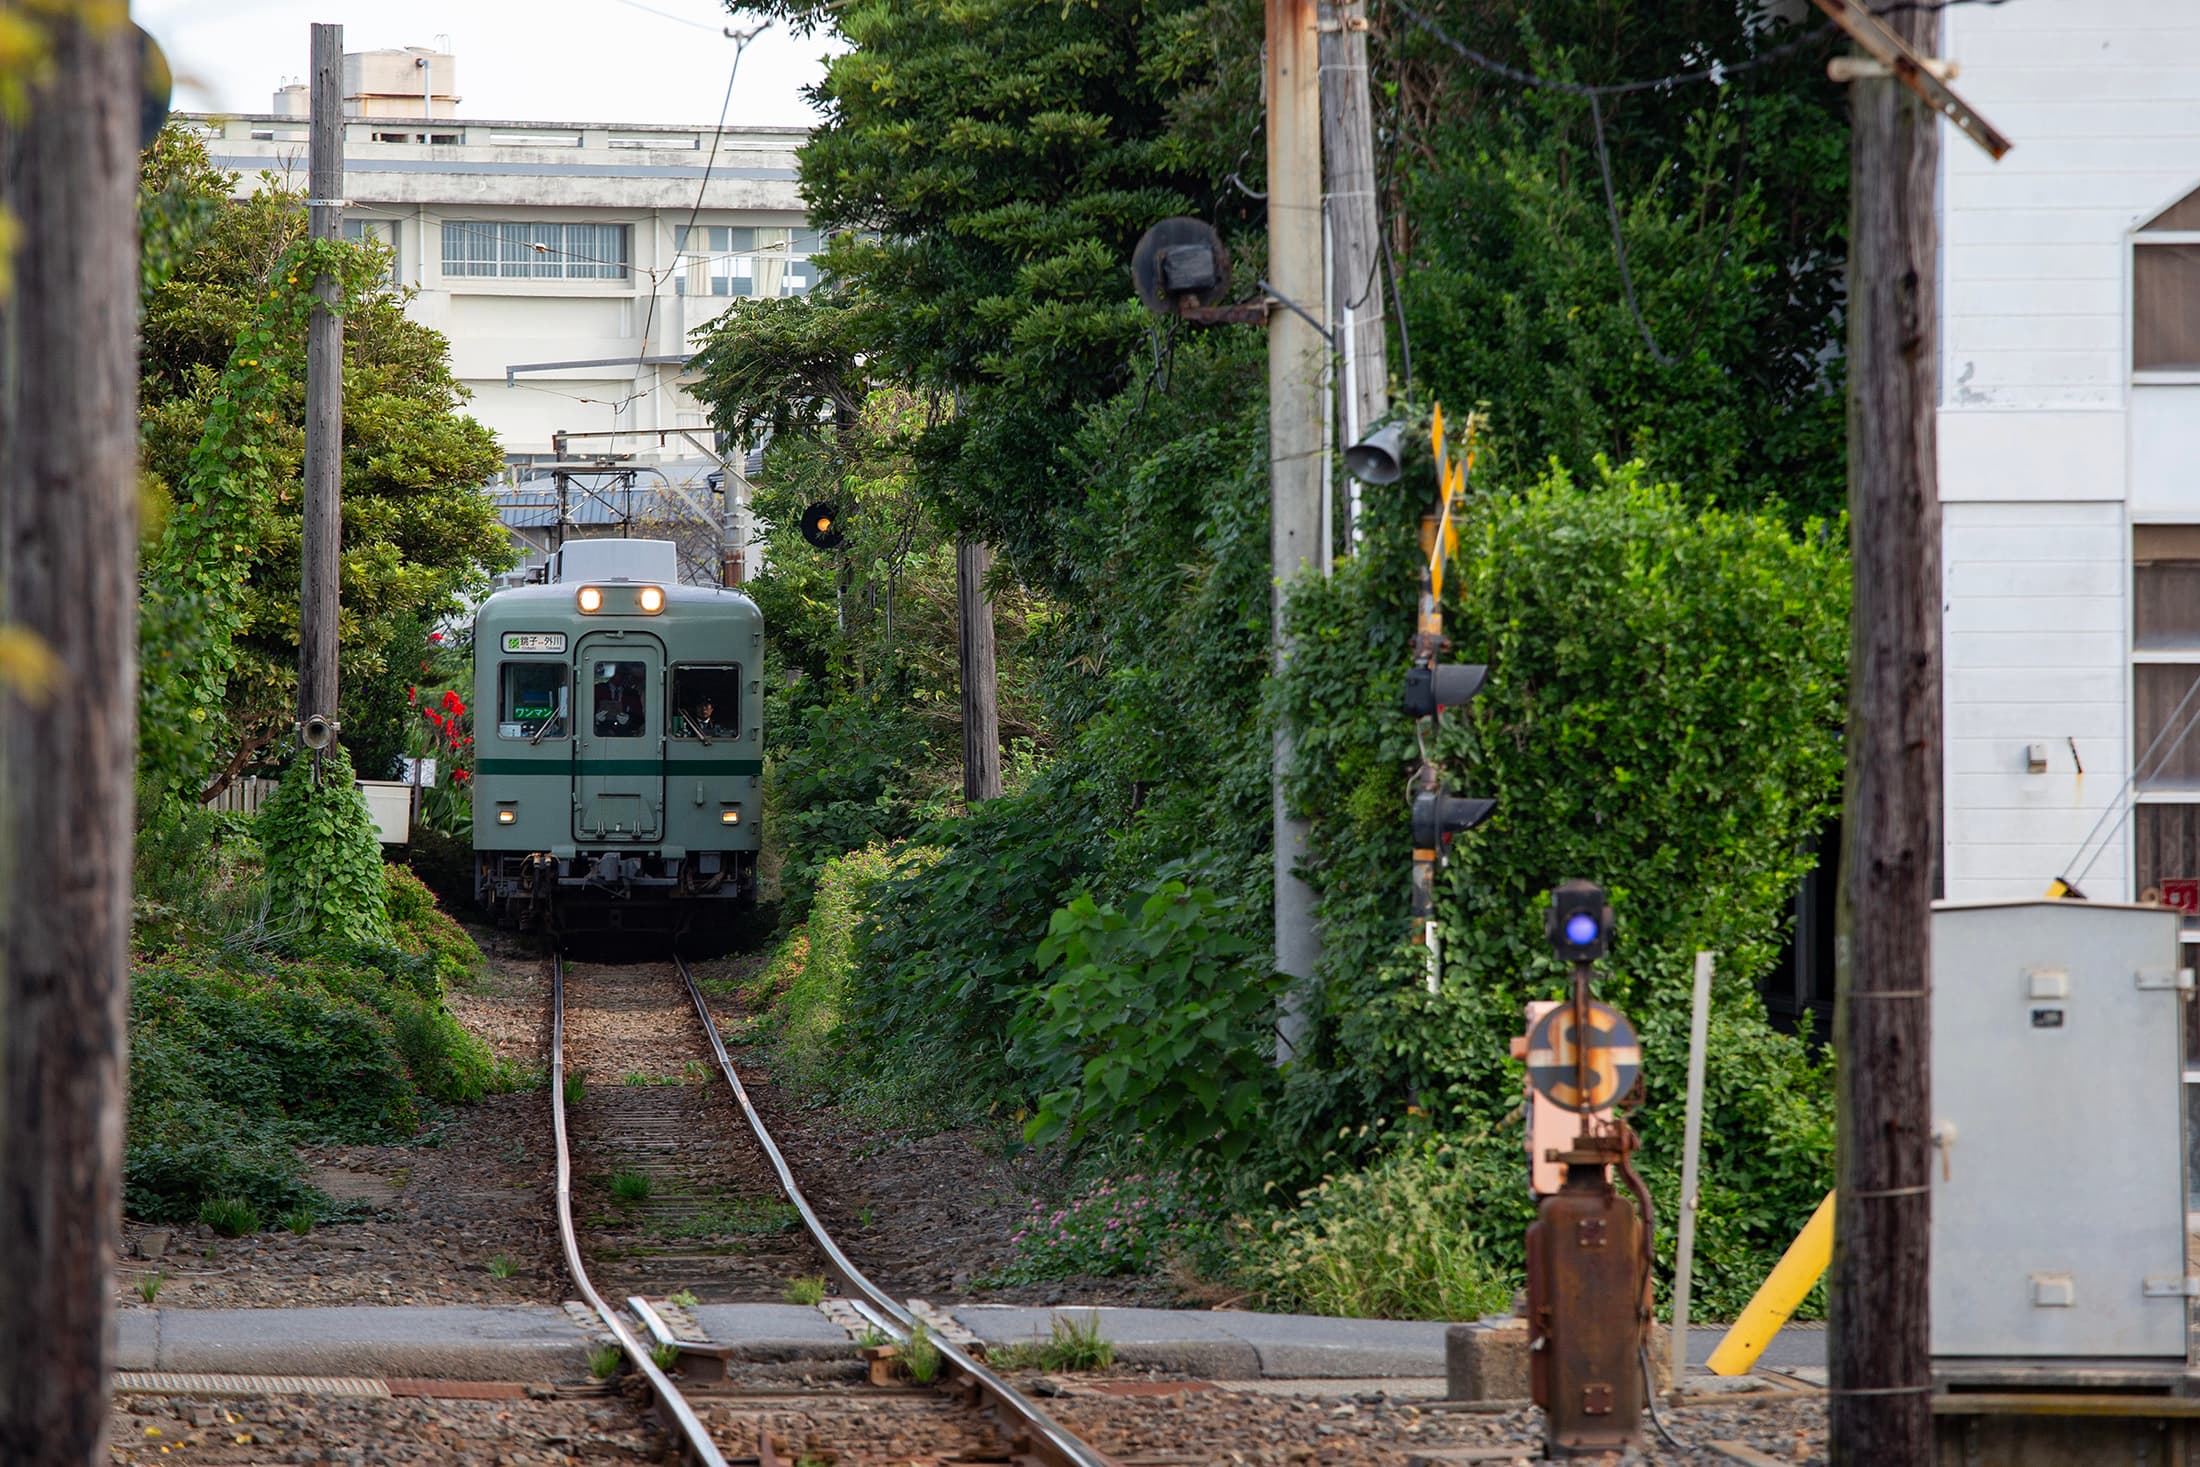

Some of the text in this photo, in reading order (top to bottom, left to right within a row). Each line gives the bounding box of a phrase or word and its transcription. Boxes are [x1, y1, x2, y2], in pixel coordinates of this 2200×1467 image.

[515, 708, 553, 718] ワンマン
[1547, 1005, 1619, 1107] S
